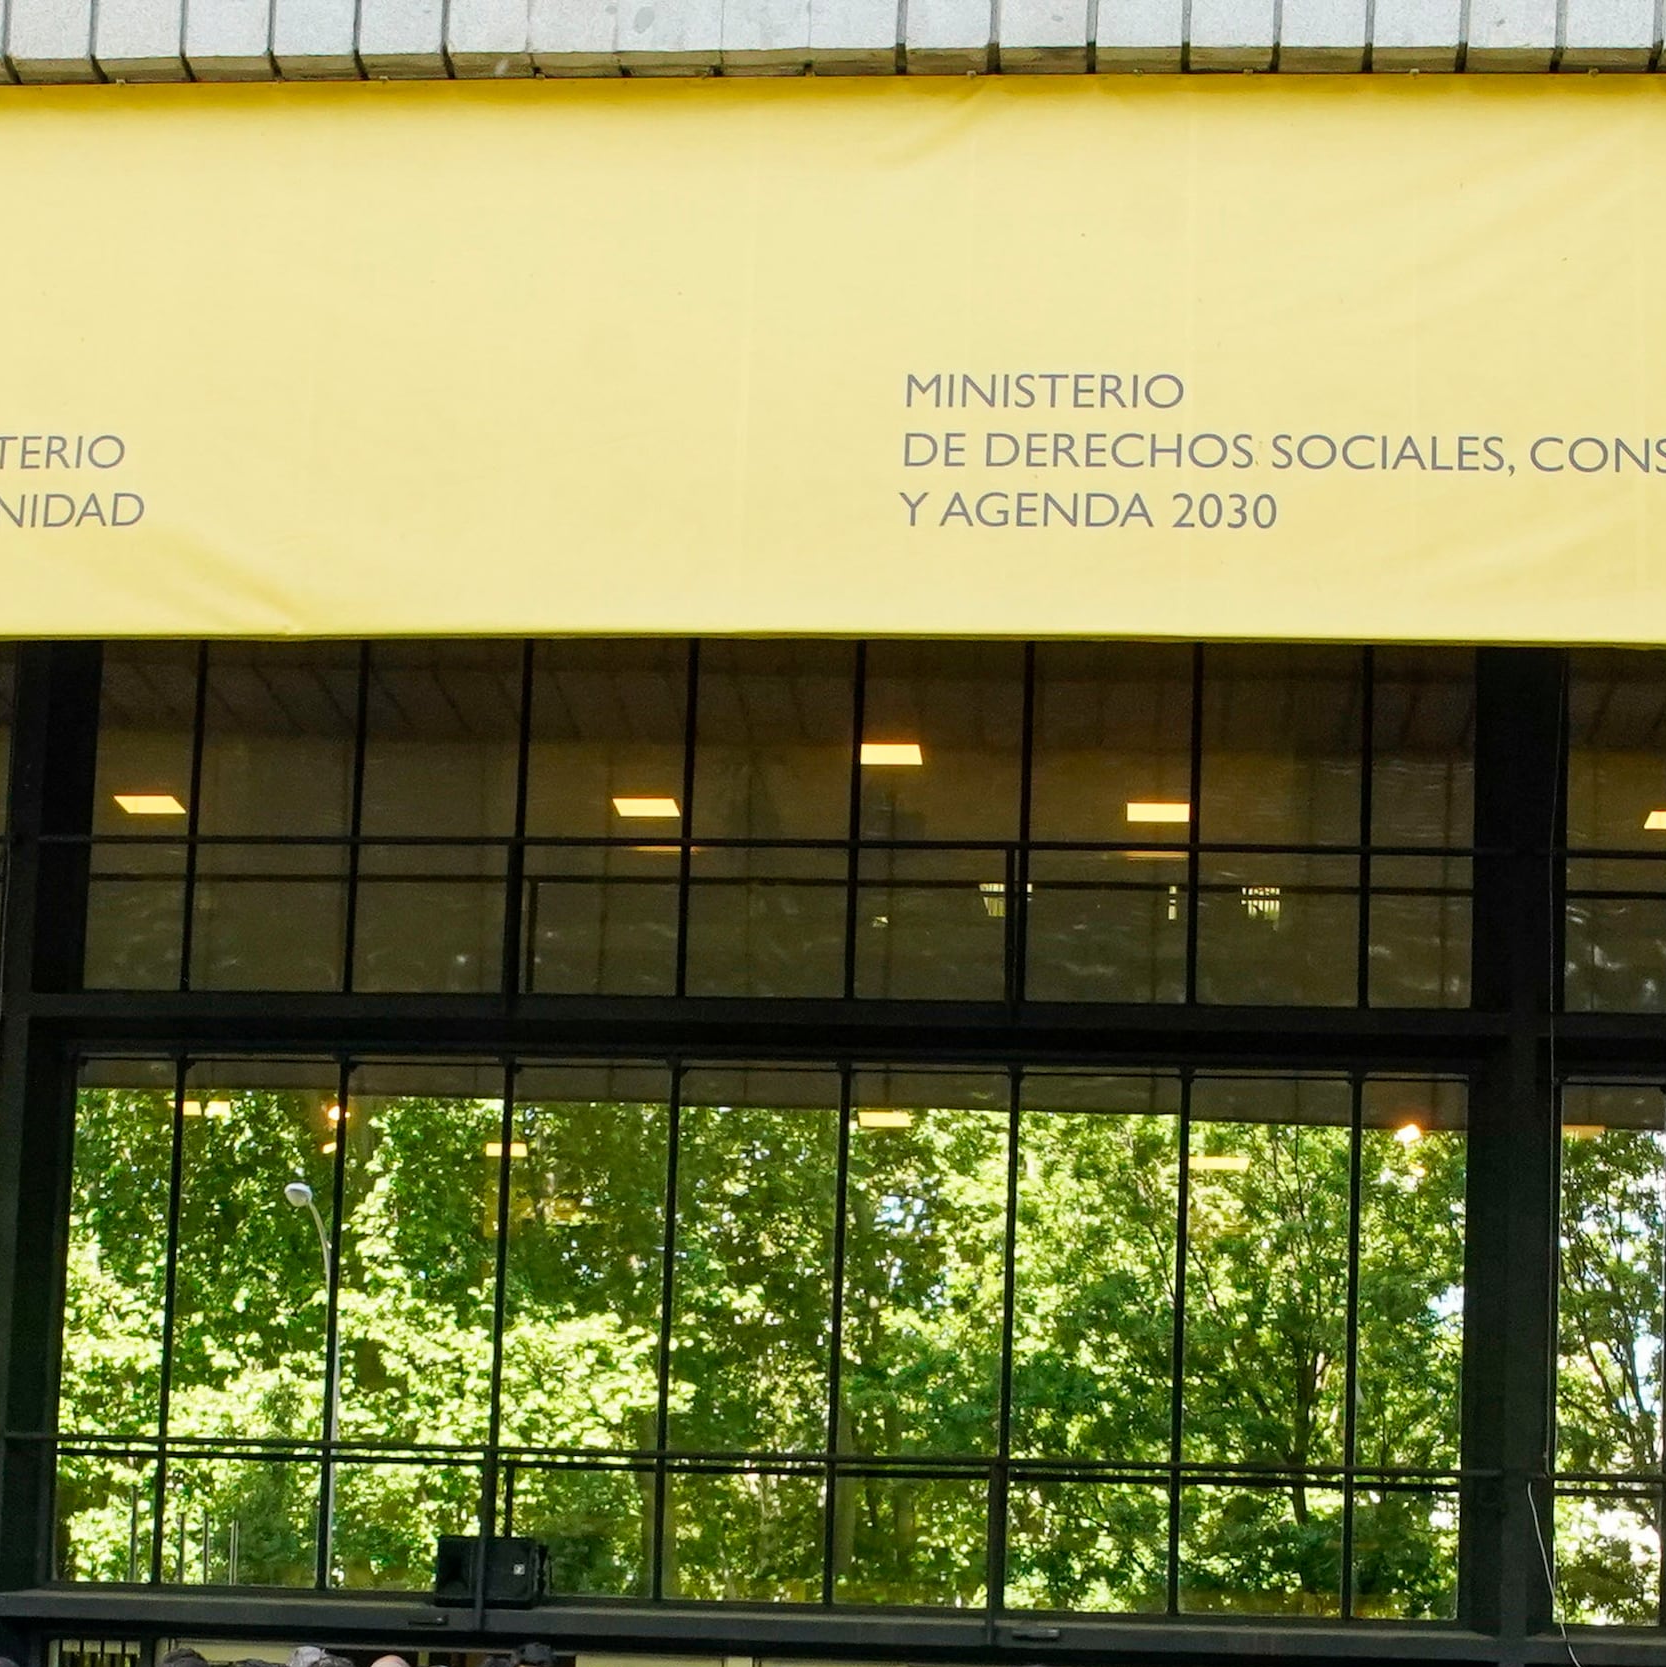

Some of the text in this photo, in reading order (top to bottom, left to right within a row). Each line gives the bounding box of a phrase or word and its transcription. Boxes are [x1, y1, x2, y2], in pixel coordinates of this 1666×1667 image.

[906, 374, 1184, 408] MINISTERIO
[904, 433, 966, 467] DE
[985, 433, 1254, 468] DERECHOS
[1271, 434, 1516, 476] SOCIALES,
[899, 492, 1278, 528] Y AGENDA 2030
